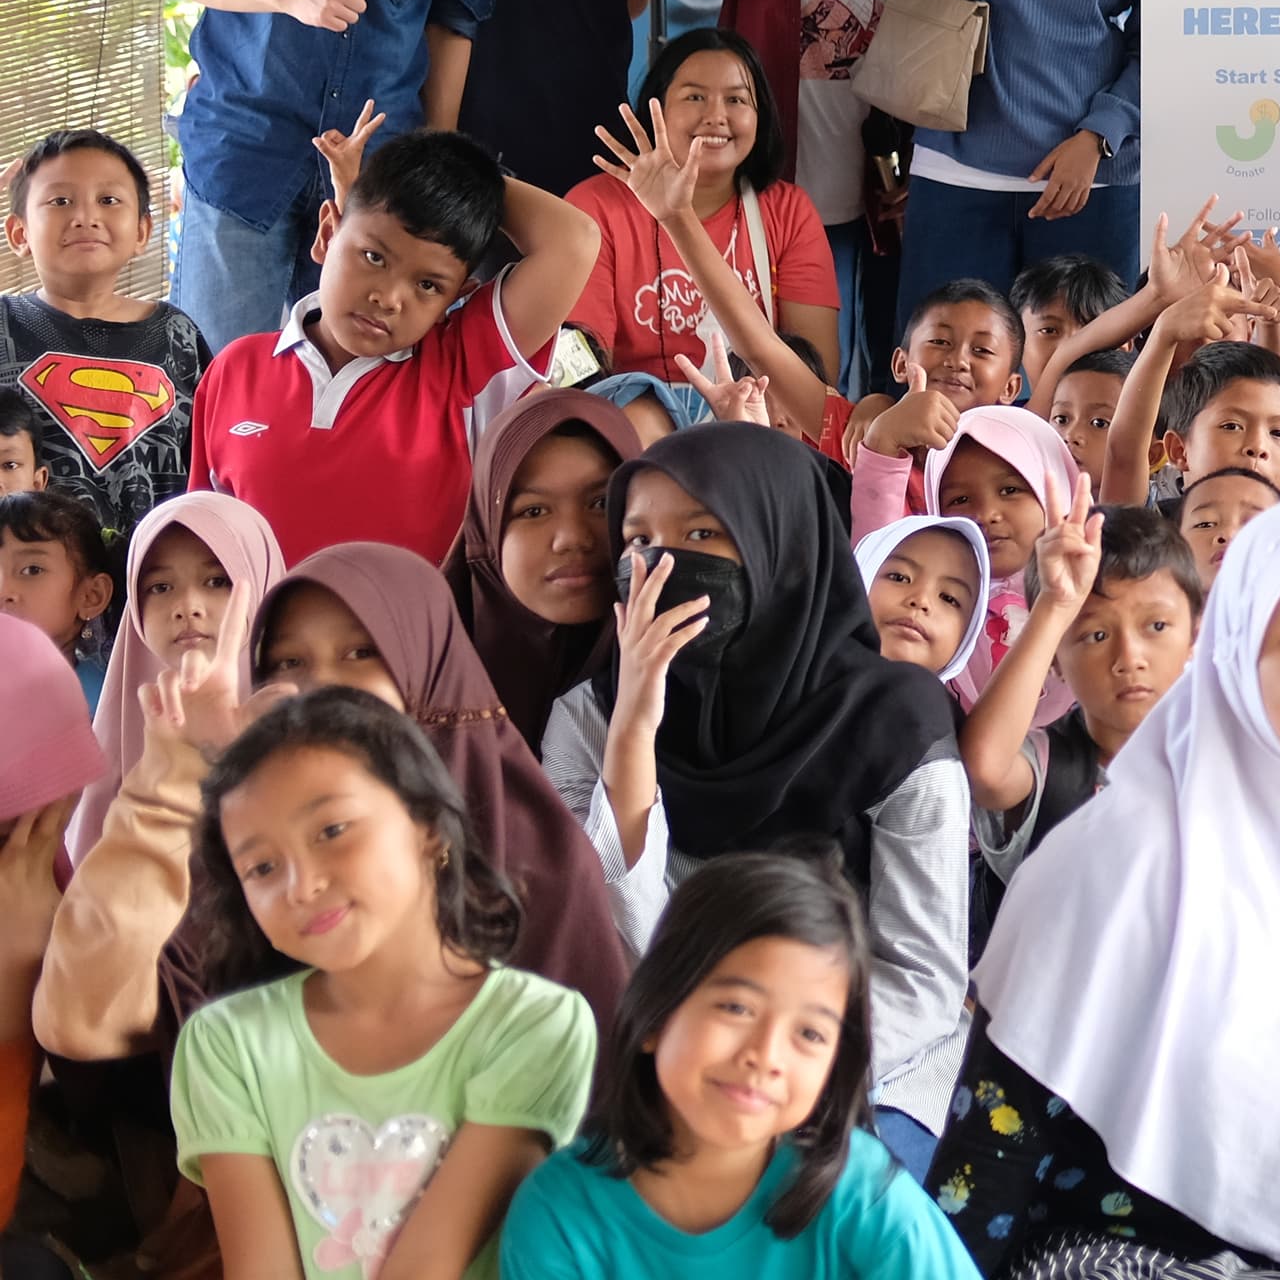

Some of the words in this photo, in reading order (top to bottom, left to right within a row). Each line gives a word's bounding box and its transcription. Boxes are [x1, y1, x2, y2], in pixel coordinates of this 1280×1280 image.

[1183, 7, 1280, 35] HERE
[1215, 69, 1267, 84] Start
[1225, 164, 1266, 179] Donate
